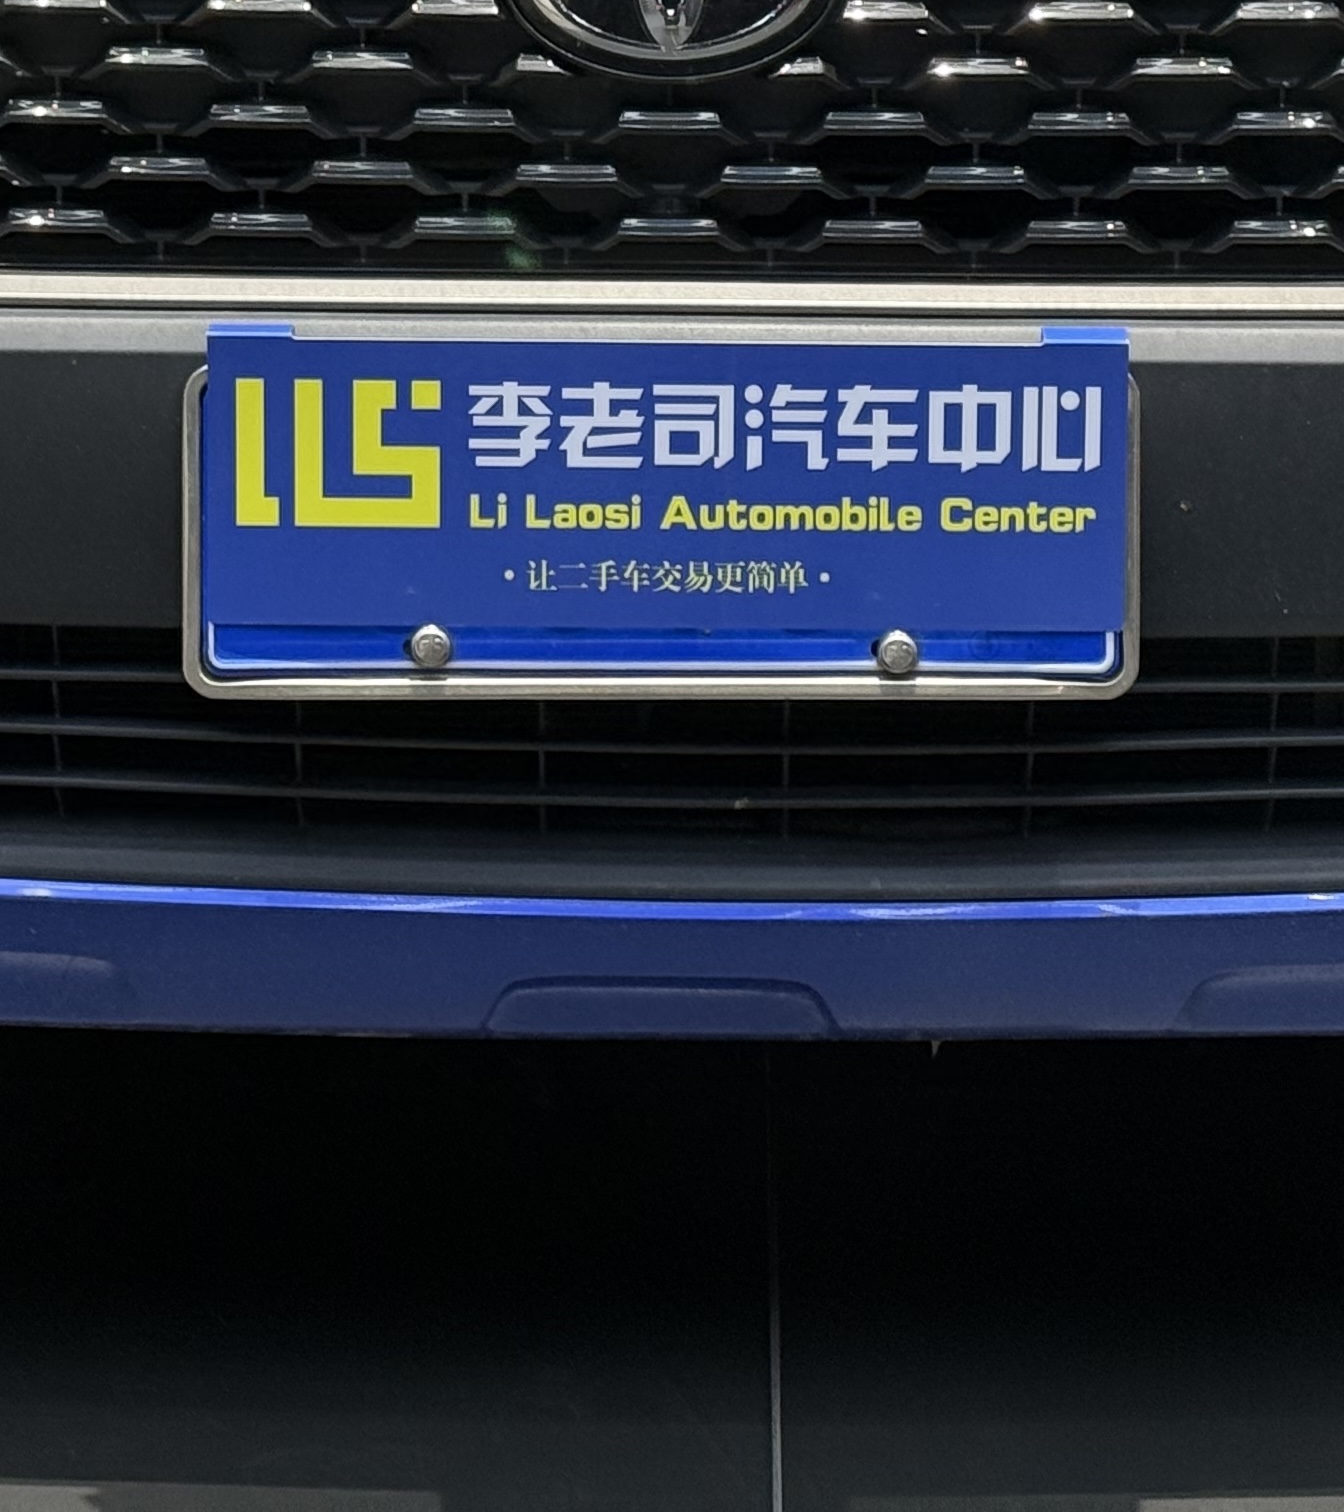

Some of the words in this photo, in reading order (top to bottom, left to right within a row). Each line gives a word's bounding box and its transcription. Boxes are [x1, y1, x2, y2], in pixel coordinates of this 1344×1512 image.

[468, 381, 1102, 474] 李老司汽车中心
[469, 492, 508, 529] Li
[525, 493, 642, 530] Laosi
[659, 495, 923, 533] Automobile
[939, 496, 1097, 534] Center
